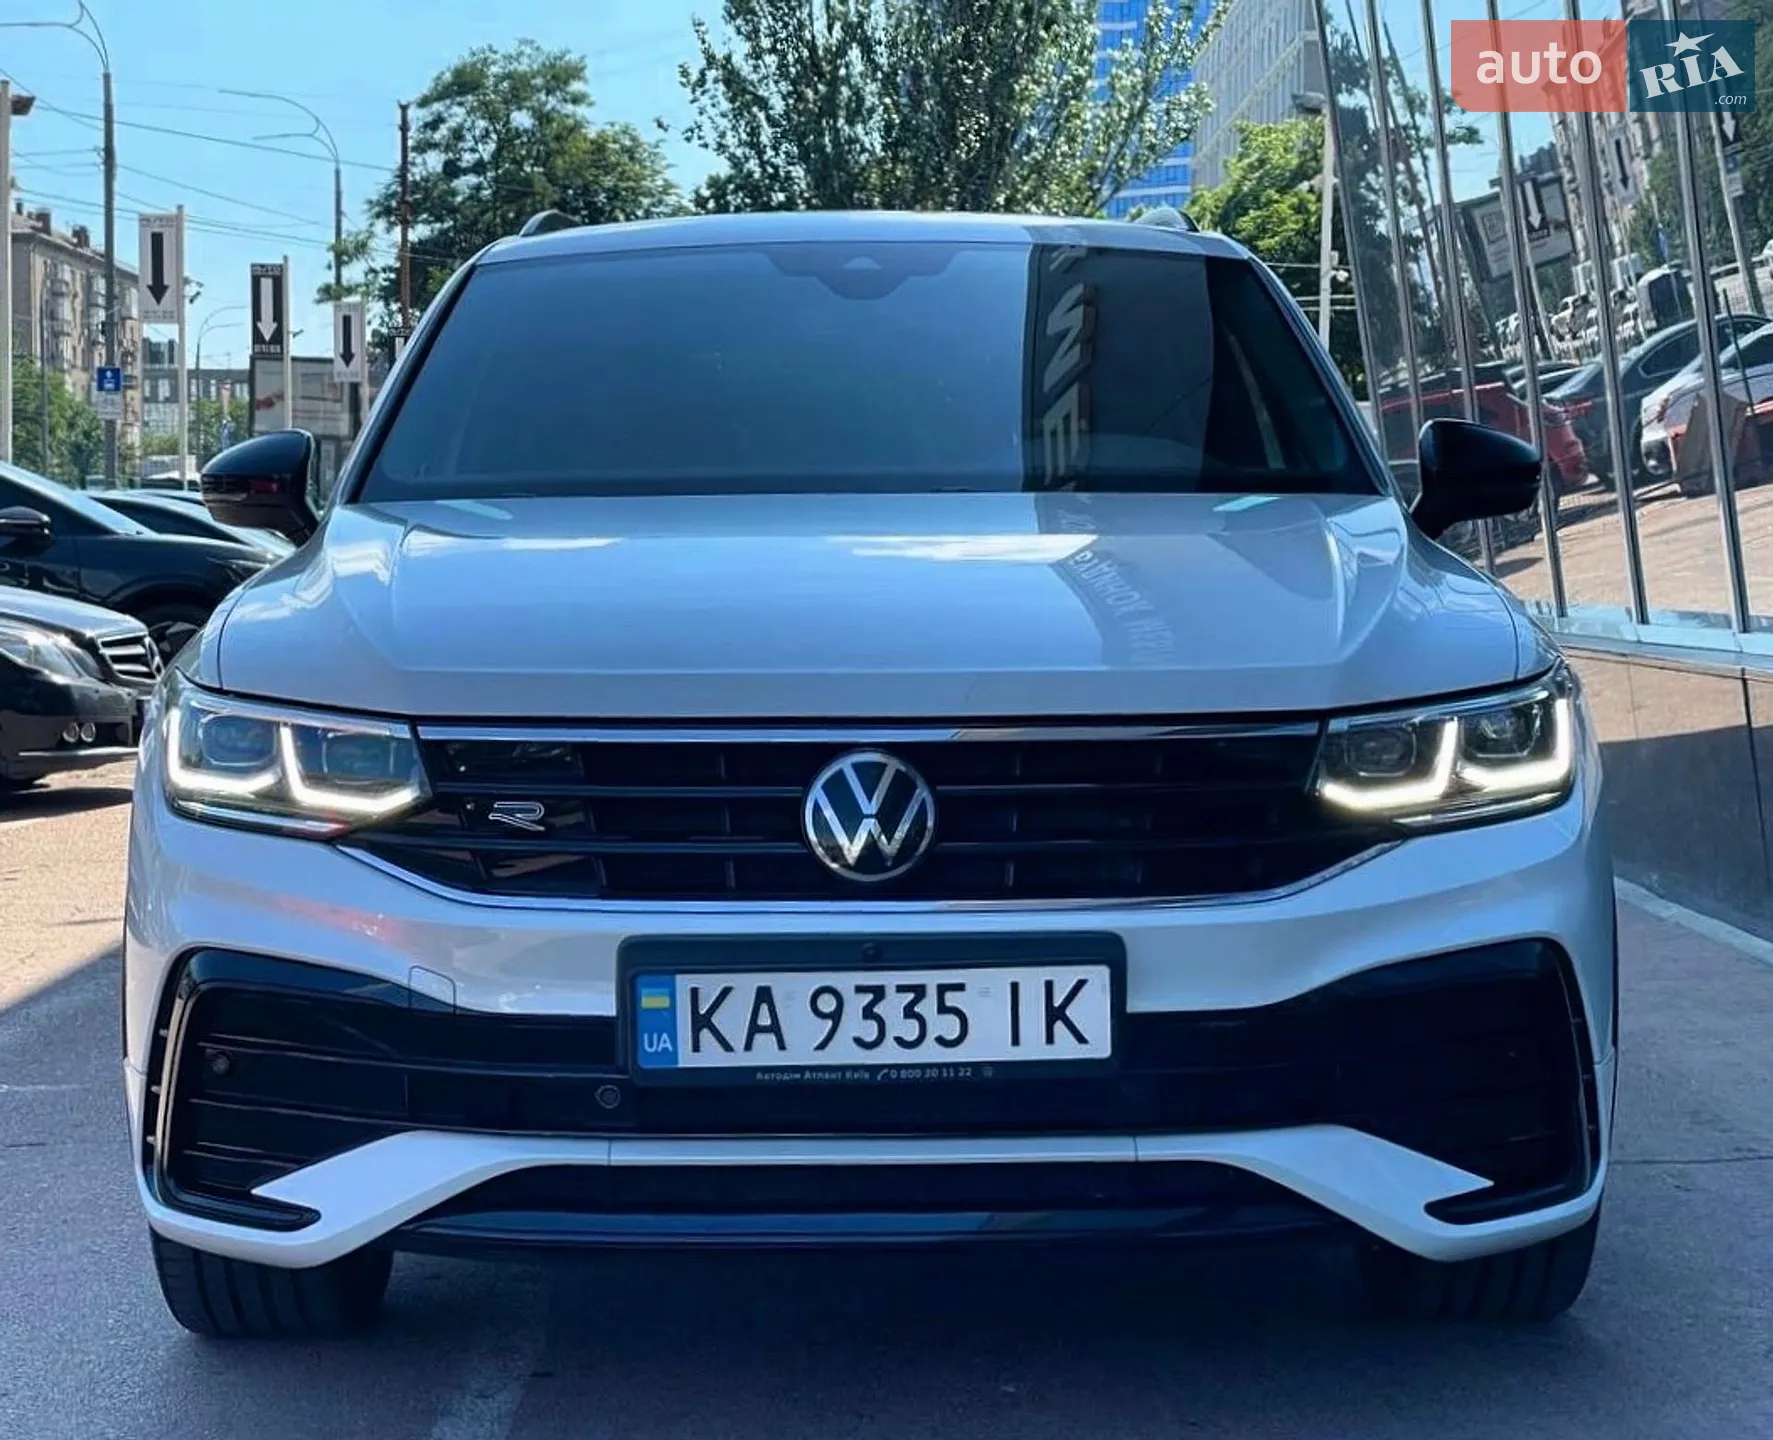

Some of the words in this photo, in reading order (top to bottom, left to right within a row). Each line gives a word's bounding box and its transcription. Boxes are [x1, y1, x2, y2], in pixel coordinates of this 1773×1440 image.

[488, 801, 545, 831] R
[689, 984, 787, 1052] KA
[809, 982, 968, 1051] 9335
[1010, 979, 1089, 1046] IK
[643, 1032, 673, 1053] UA
